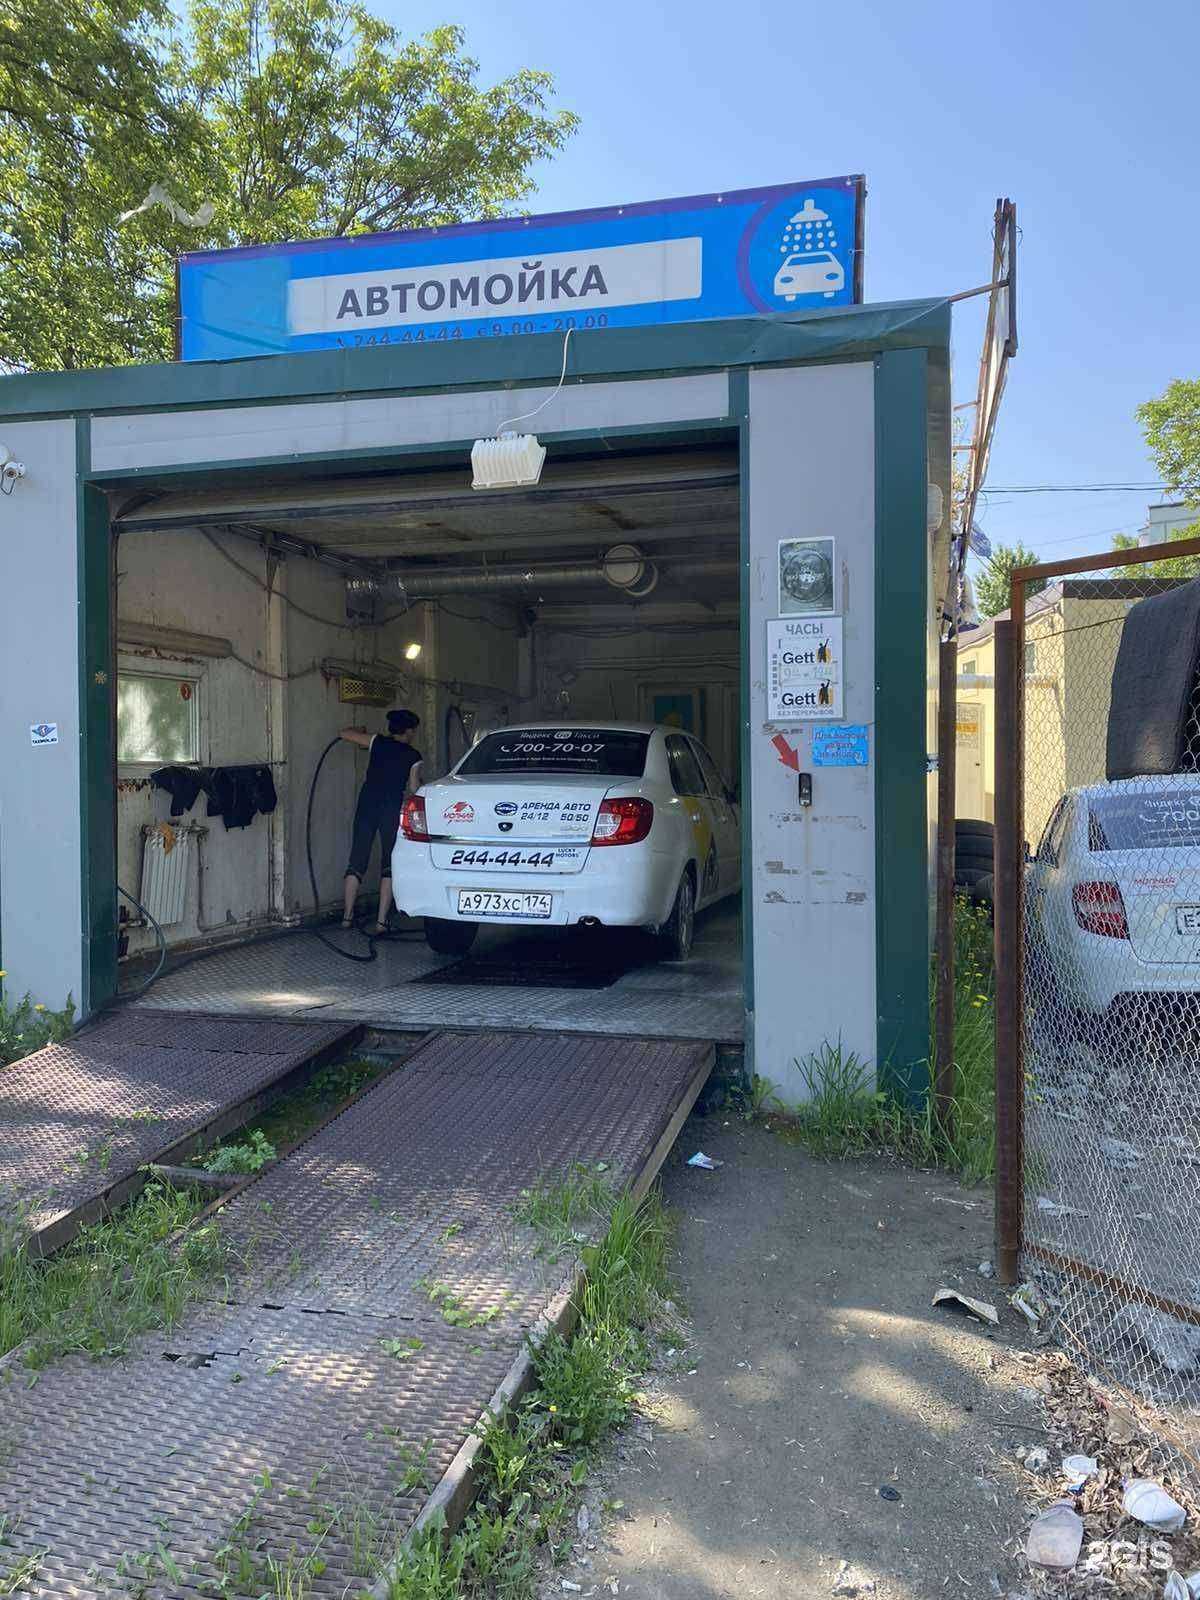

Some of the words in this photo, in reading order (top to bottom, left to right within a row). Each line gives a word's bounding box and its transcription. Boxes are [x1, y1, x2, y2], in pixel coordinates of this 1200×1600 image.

[336, 260, 608, 320] АВТОМОЙКА
[785, 623, 823, 635] ЧАСЫ
[782, 651, 815, 664] Gett
[781, 692, 816, 706] Gett
[512, 743, 605, 753] 700-70-07
[520, 802, 560, 811] АРЕНДА
[562, 803, 592, 812] АВТО
[520, 812, 550, 821] 24/12
[560, 813, 590, 823] 50/50
[451, 850, 555, 868] 244-44-44
[463, 894, 521, 911] А973ХС
[524, 895, 547, 908] 174
